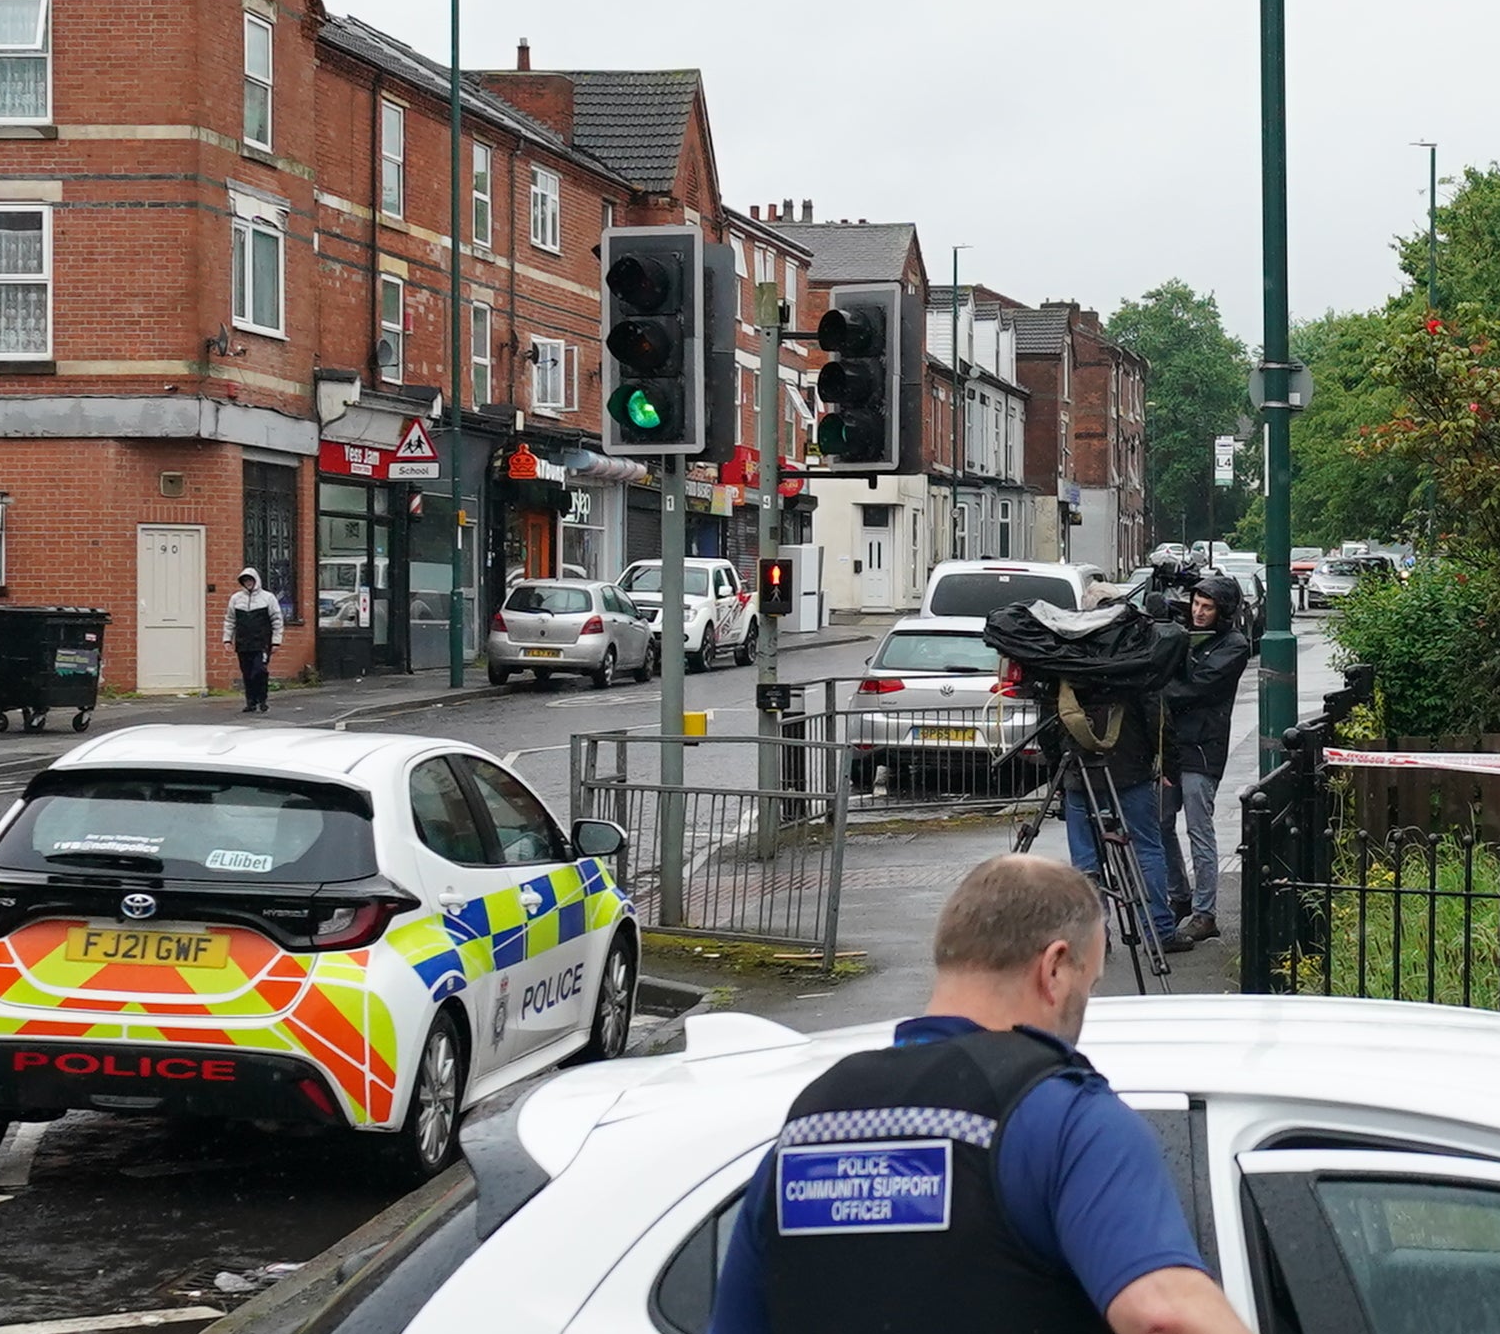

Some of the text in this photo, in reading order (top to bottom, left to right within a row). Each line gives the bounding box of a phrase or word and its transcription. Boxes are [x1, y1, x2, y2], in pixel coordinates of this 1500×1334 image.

[399, 466, 429, 476] School
[1217, 458, 1231, 468] L4
[209, 850, 268, 871] #Lilibet
[83, 932, 212, 962] FJ21 GWF
[521, 962, 585, 1020] POLICE
[13, 1051, 237, 1082] POLICE
[837, 1155, 890, 1176] POLICE
[785, 1174, 941, 1201] COMMUNITY SUPPORT
[831, 1199, 893, 1222] OFFICER
